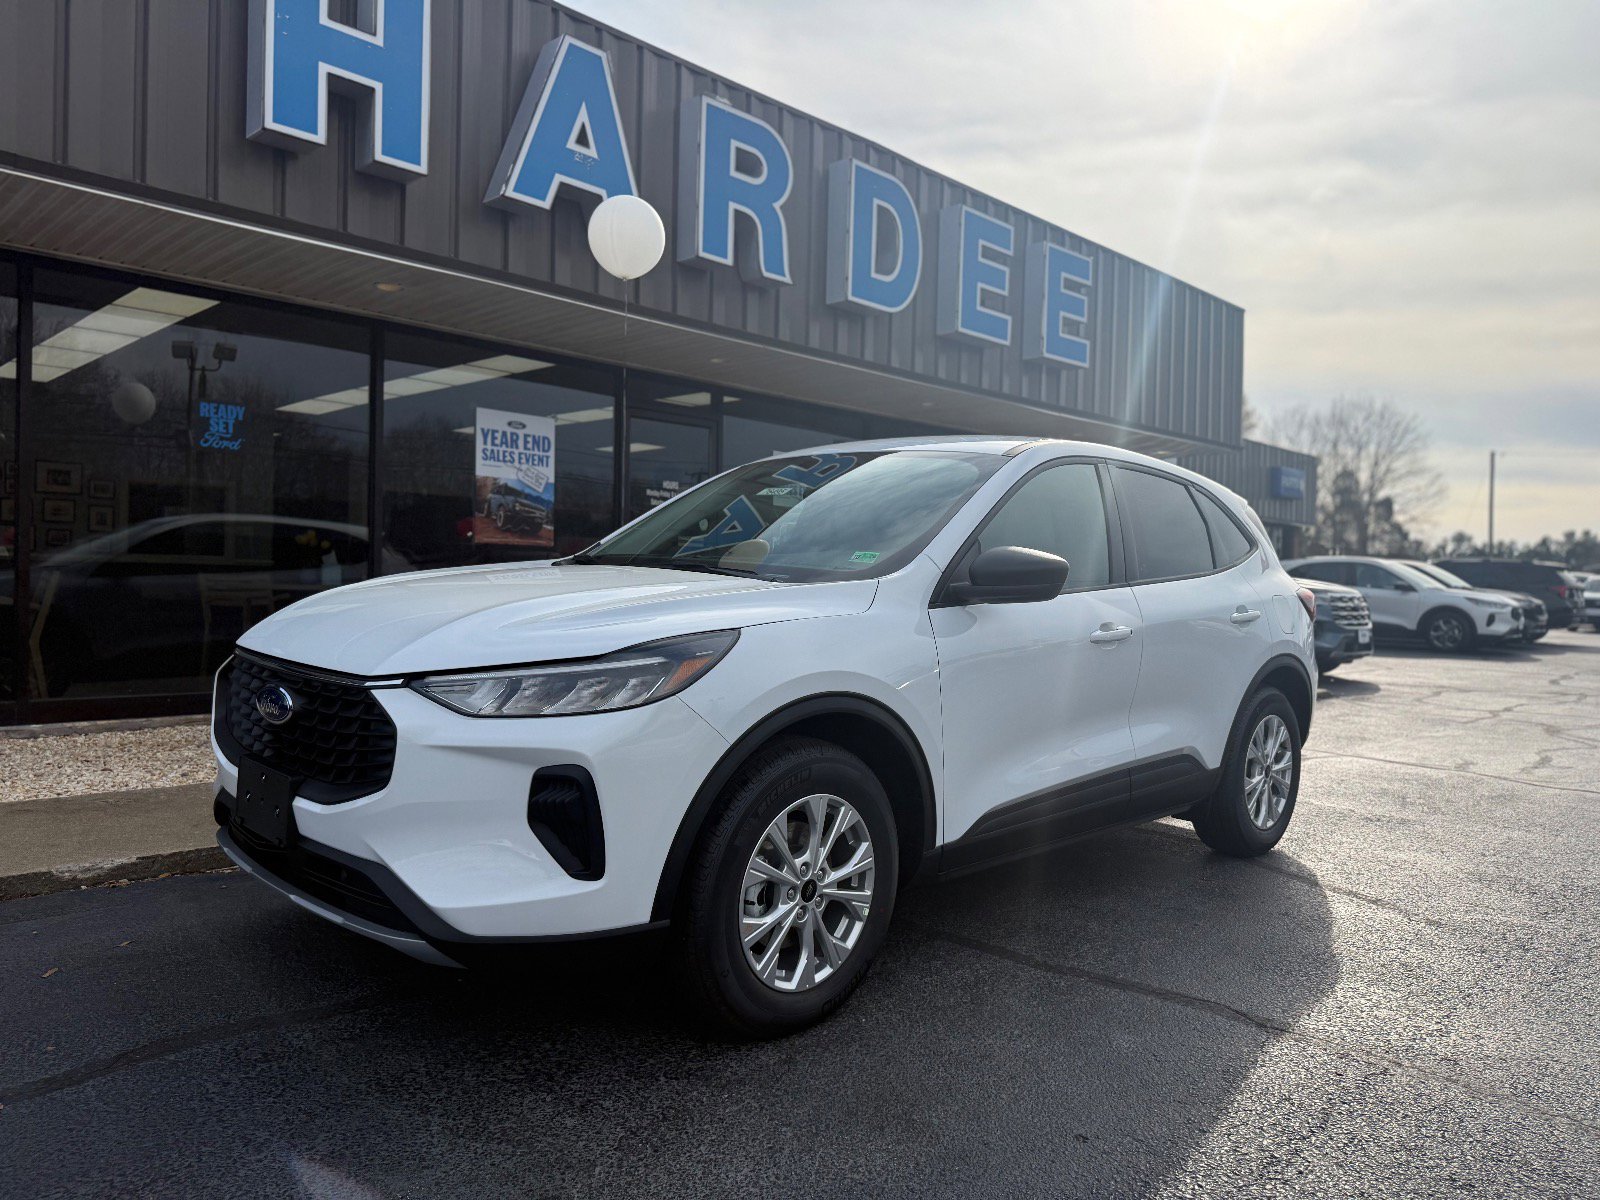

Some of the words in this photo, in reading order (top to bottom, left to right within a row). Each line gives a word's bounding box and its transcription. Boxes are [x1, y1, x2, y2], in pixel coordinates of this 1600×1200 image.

[252, 0, 1093, 370] HARDEE
[199, 401, 246, 421] READY
[210, 417, 235, 433] SET
[200, 431, 243, 450] Ford
[480, 427, 520, 450] YEAR
[523, 433, 551, 453] END
[481, 447, 515, 465] SALES
[518, 452, 551, 468] EVENT
[756, 768, 812, 817] MICHELIN
